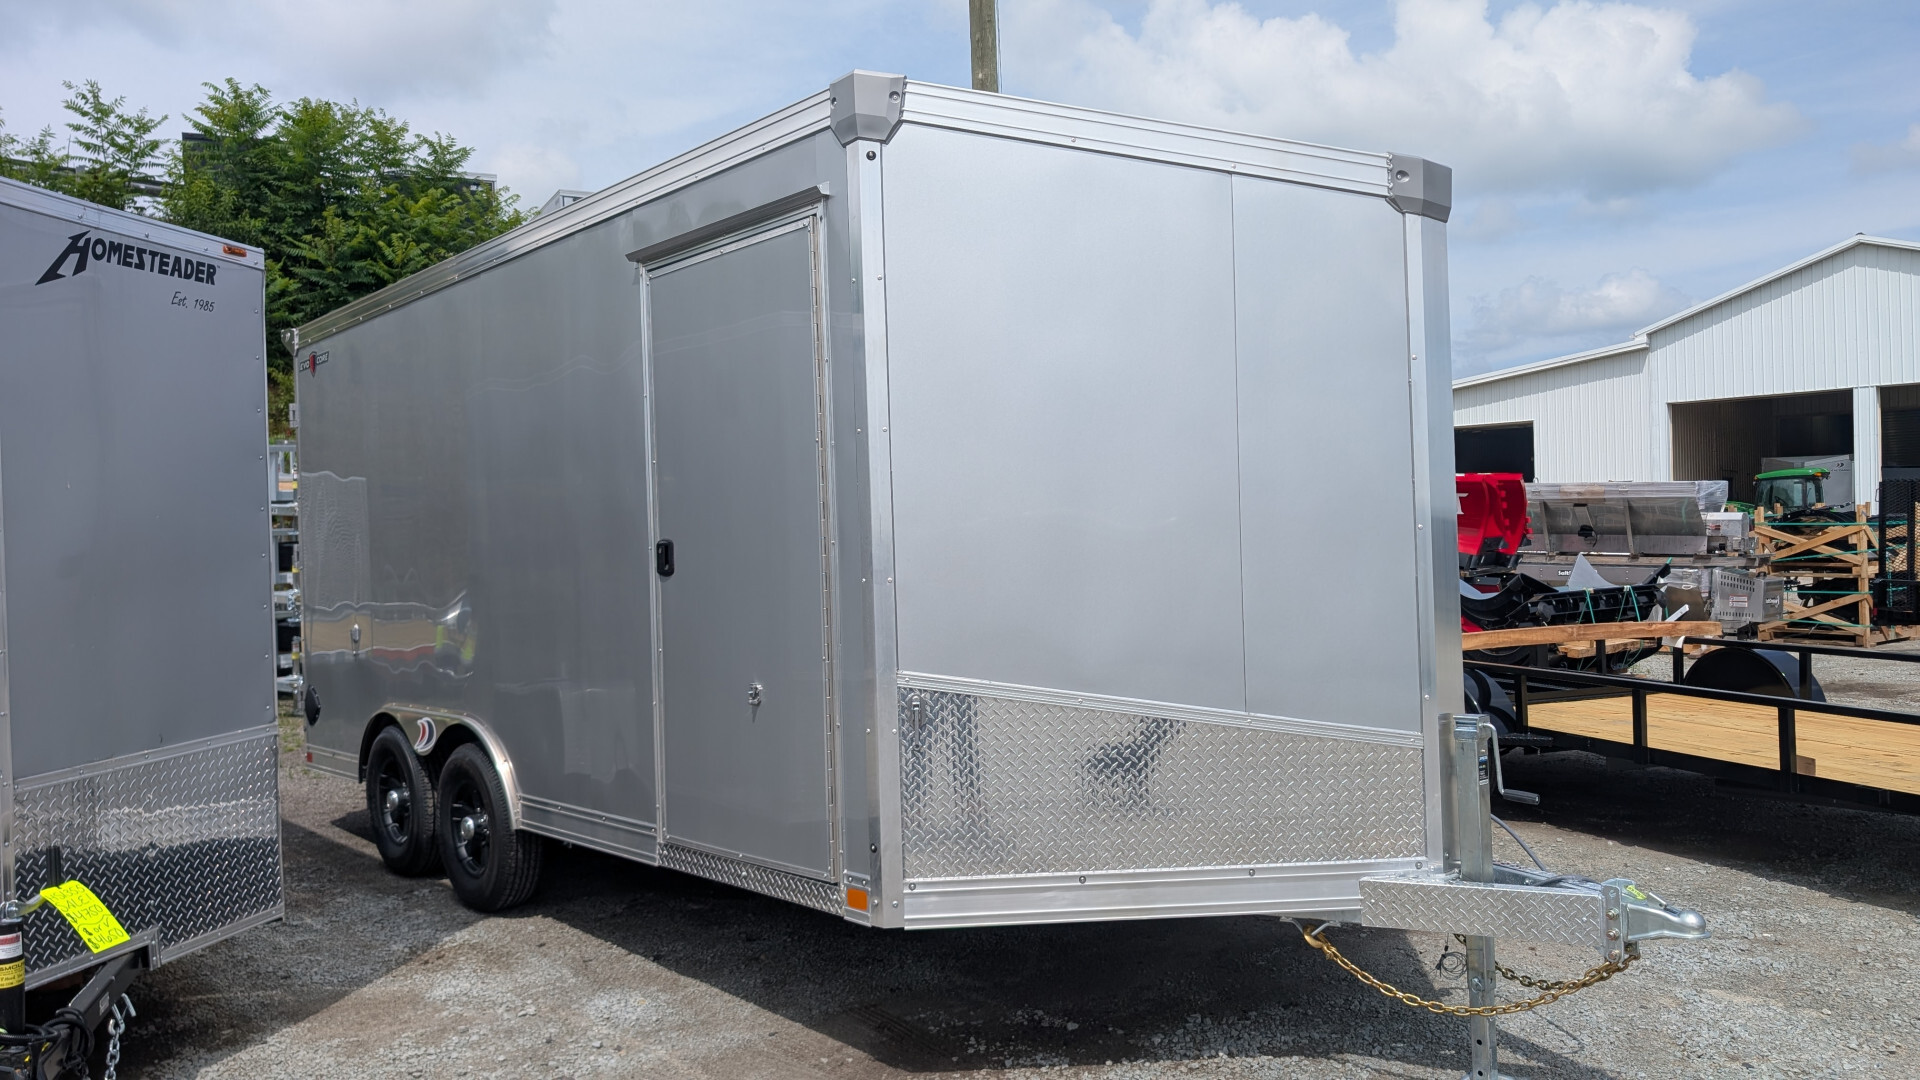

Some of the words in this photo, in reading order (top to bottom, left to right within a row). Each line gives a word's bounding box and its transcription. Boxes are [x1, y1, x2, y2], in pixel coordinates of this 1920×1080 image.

[35, 230, 217, 286] HOMESTEADER
[171, 291, 188, 309] Est.
[194, 299, 215, 313] 1985
